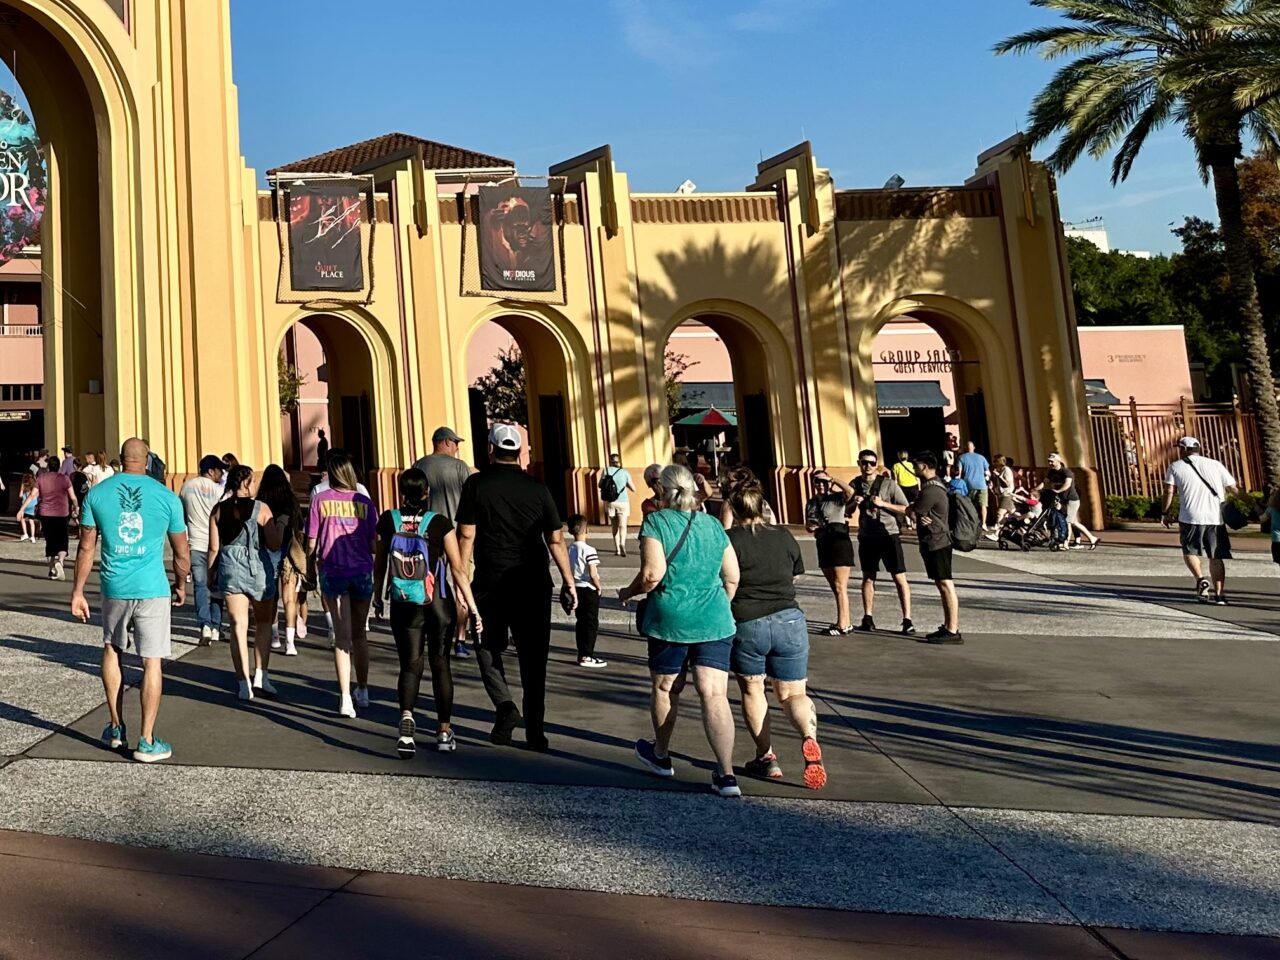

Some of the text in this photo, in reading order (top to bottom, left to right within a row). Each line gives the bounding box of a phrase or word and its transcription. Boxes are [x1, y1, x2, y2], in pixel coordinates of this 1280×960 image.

[320, 270, 344, 279] PLACE
[880, 350, 921, 363] GROUP
[893, 362, 953, 374] GUEST SERVICES
[115, 543, 134, 555] JUICY
